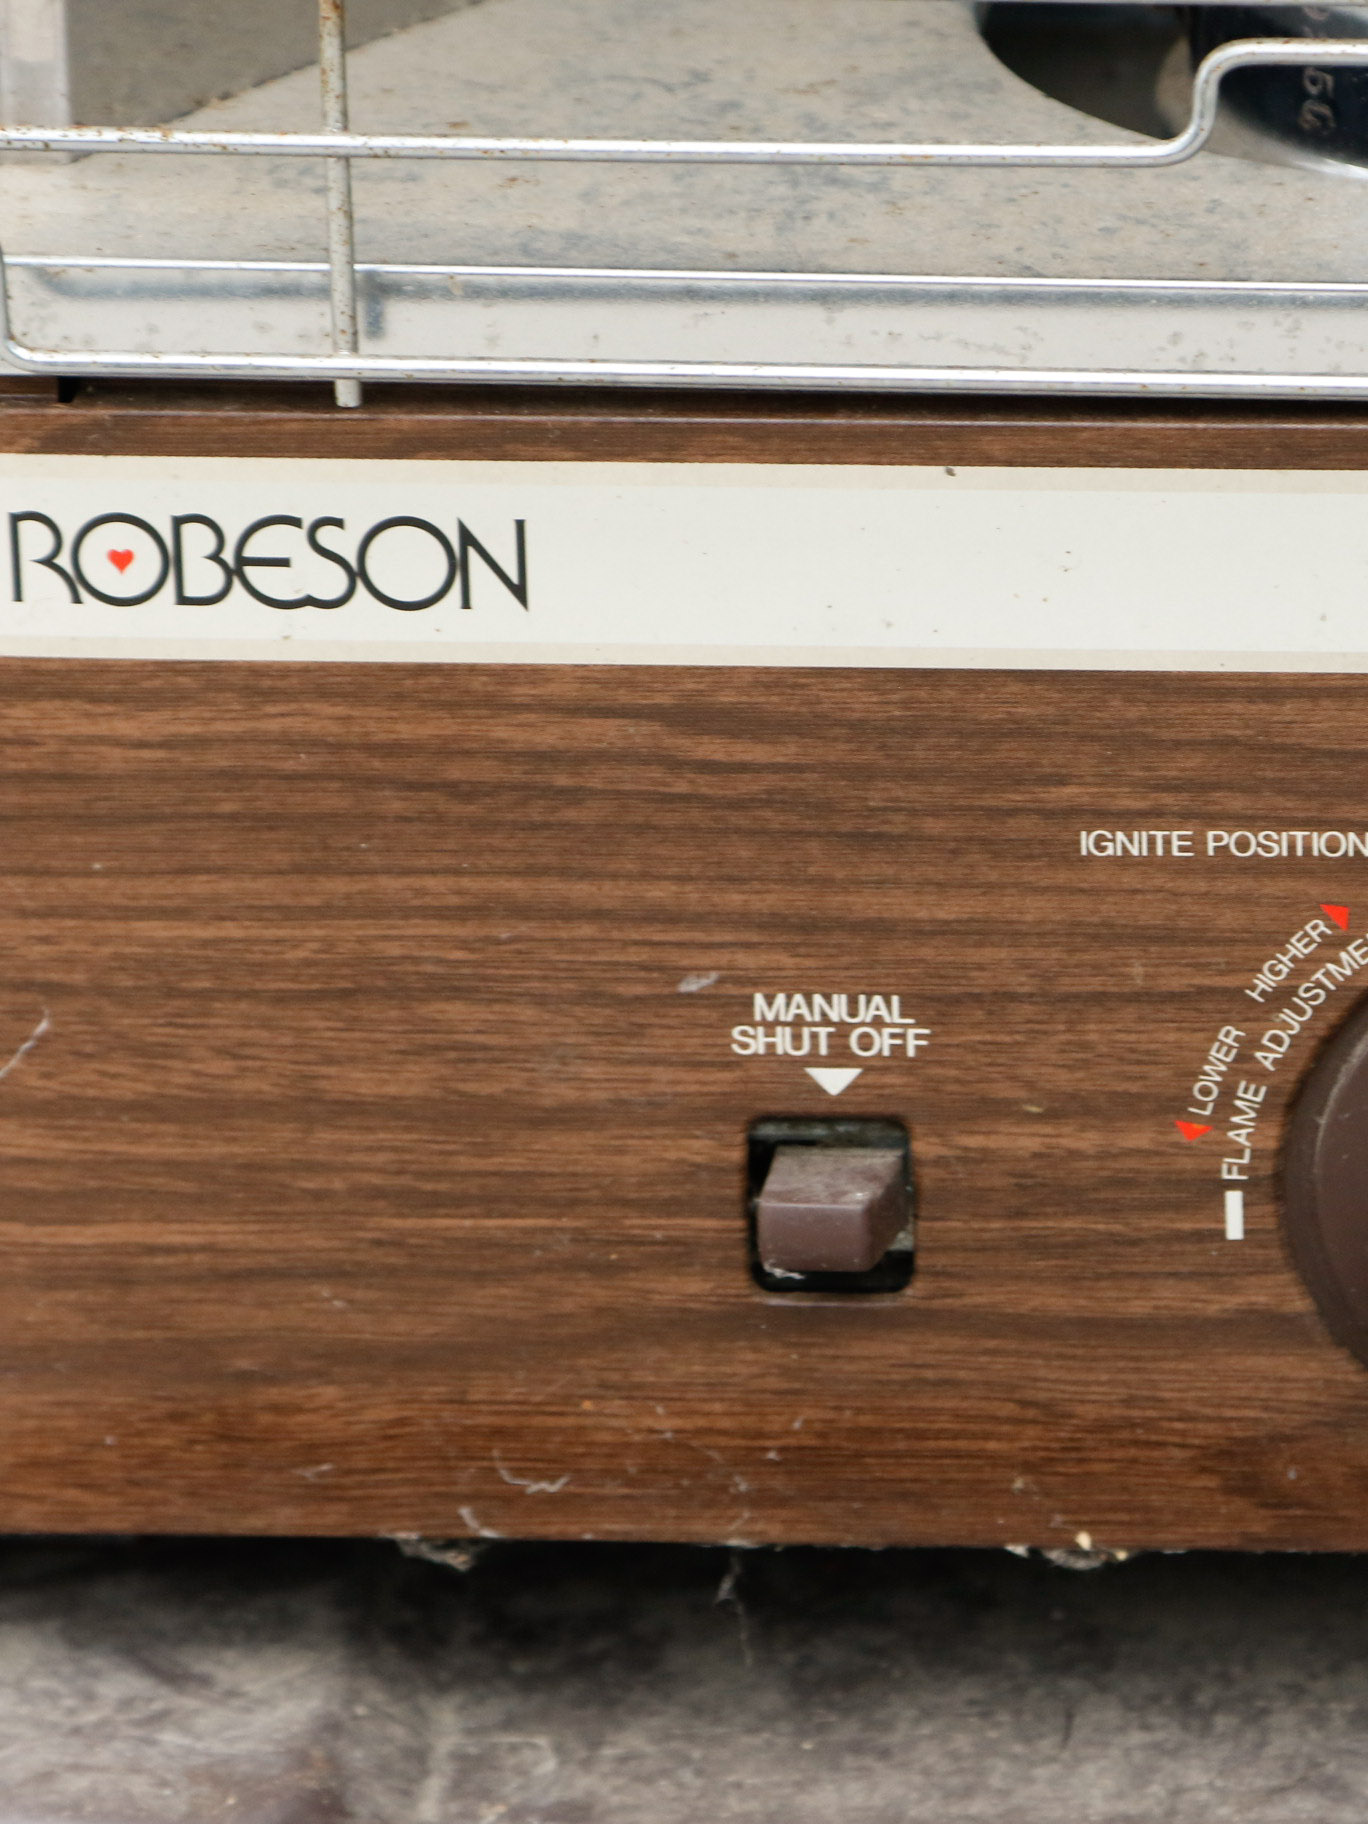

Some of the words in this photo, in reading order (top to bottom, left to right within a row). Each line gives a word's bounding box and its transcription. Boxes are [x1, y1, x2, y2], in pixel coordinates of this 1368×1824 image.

[8, 510, 529, 612] ROBESON
[1079, 830, 1194, 857] IGNITE
[1245, 919, 1333, 1003] HIGHER
[730, 1024, 837, 1056] SHUT
[849, 1026, 932, 1058] OFF
[753, 992, 916, 1025] MANUAL
[1187, 1025, 1247, 1116] LOWER
[1221, 1080, 1267, 1181] FLAME
